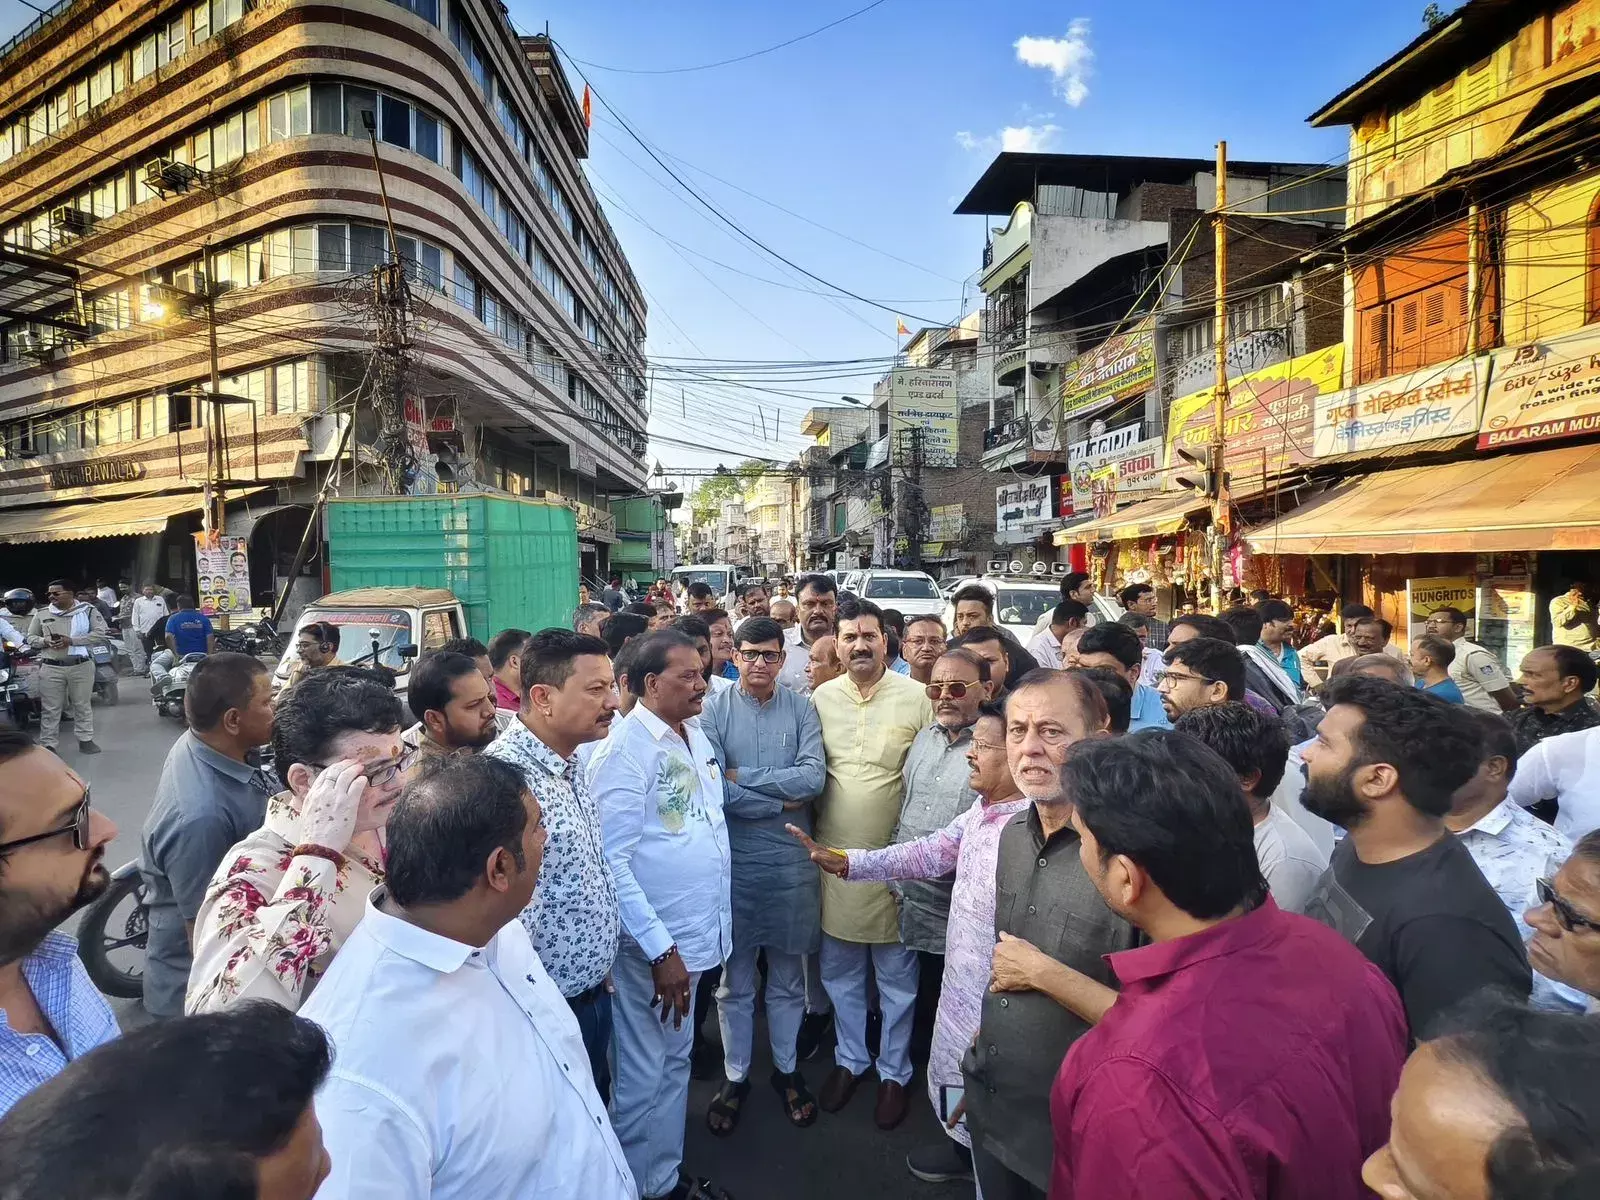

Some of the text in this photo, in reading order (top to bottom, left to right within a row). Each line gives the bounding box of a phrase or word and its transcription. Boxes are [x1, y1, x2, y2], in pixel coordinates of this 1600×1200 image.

[909, 376, 952, 388] हरिनारायण
[1504, 363, 1582, 392] Bite-size
[1534, 390, 1543, 398] A
[1547, 379, 1583, 394] wide
[1326, 402, 1358, 428] गुप्ता
[1363, 389, 1423, 414] मेडिकल
[1520, 395, 1565, 410] frozen
[1488, 421, 1566, 445] BALARAM
[1412, 588, 1474, 604] HUNGRITOS
